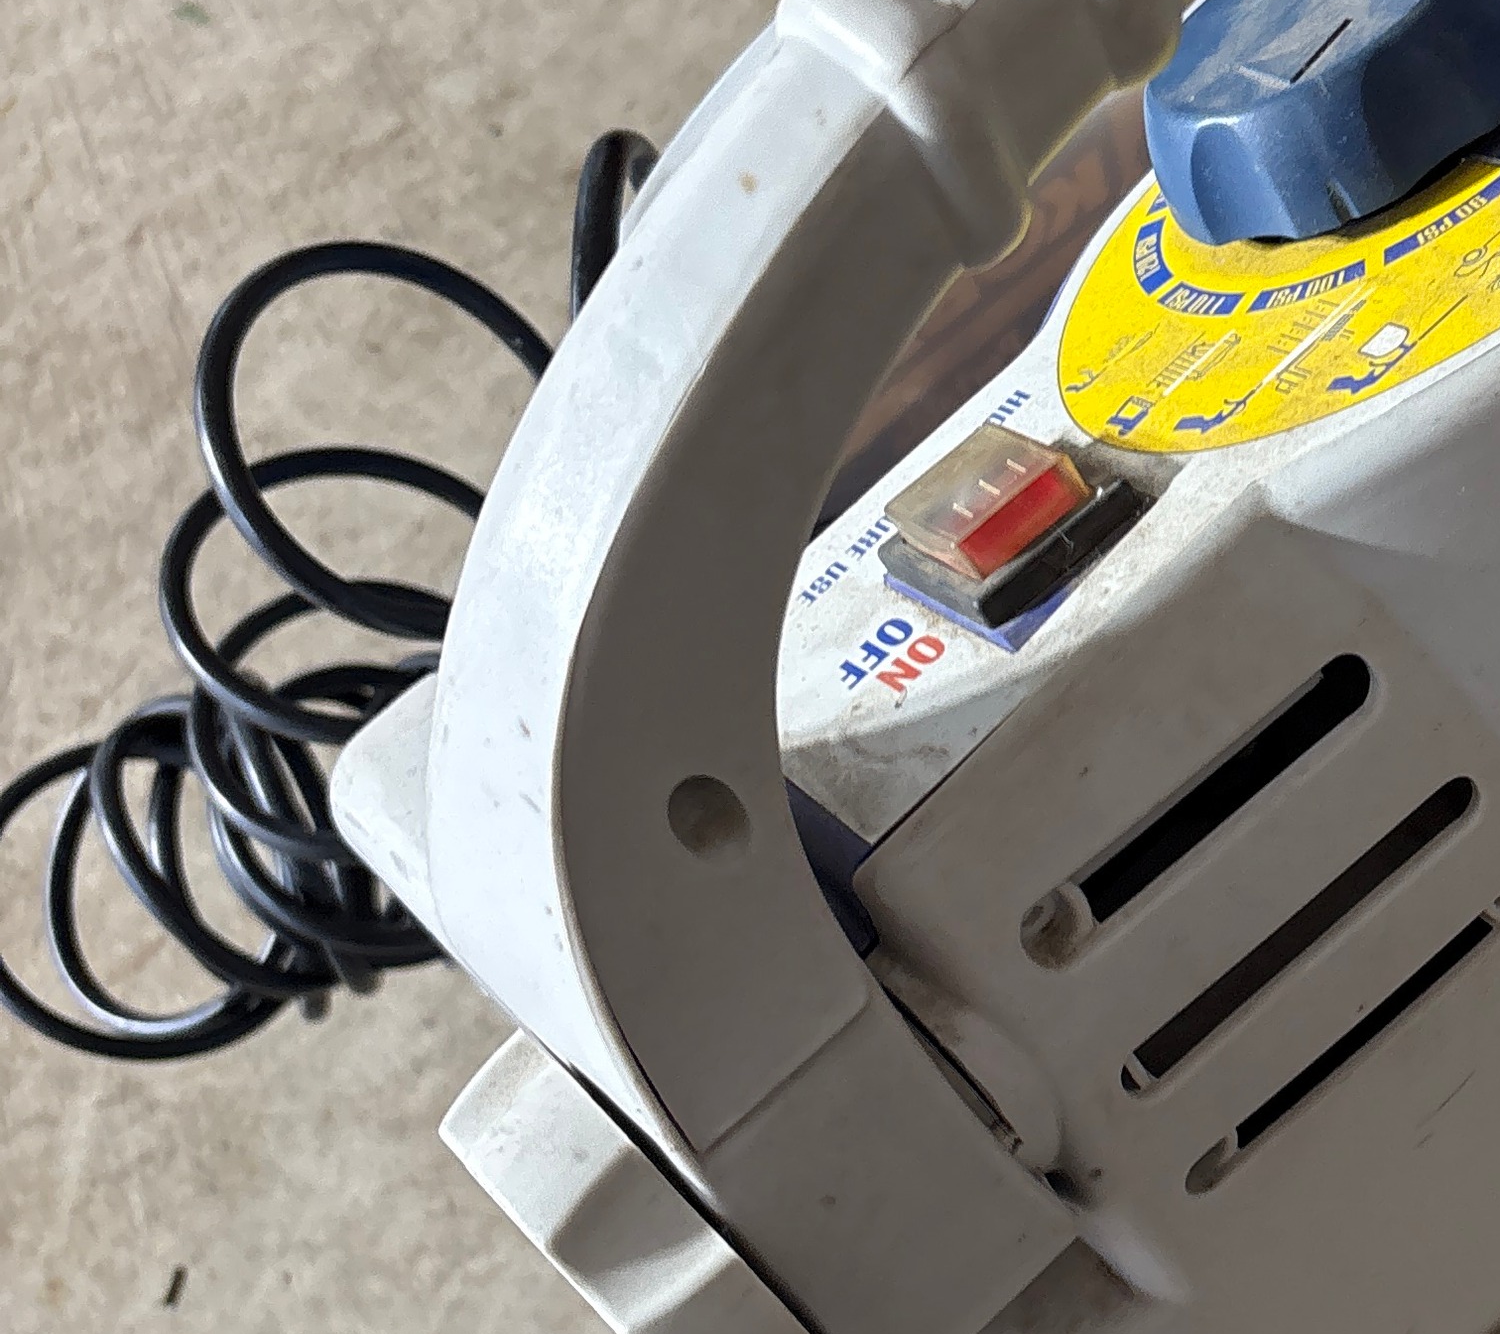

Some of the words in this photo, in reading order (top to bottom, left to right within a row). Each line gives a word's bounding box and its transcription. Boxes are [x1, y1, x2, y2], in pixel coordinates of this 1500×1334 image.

[1416, 216, 1453, 245] PSI
[1266, 287, 1301, 308] PSI
[1304, 270, 1345, 298] 100
[796, 561, 848, 608] USE
[839, 617, 914, 690] OFF
[876, 634, 946, 694] ON
